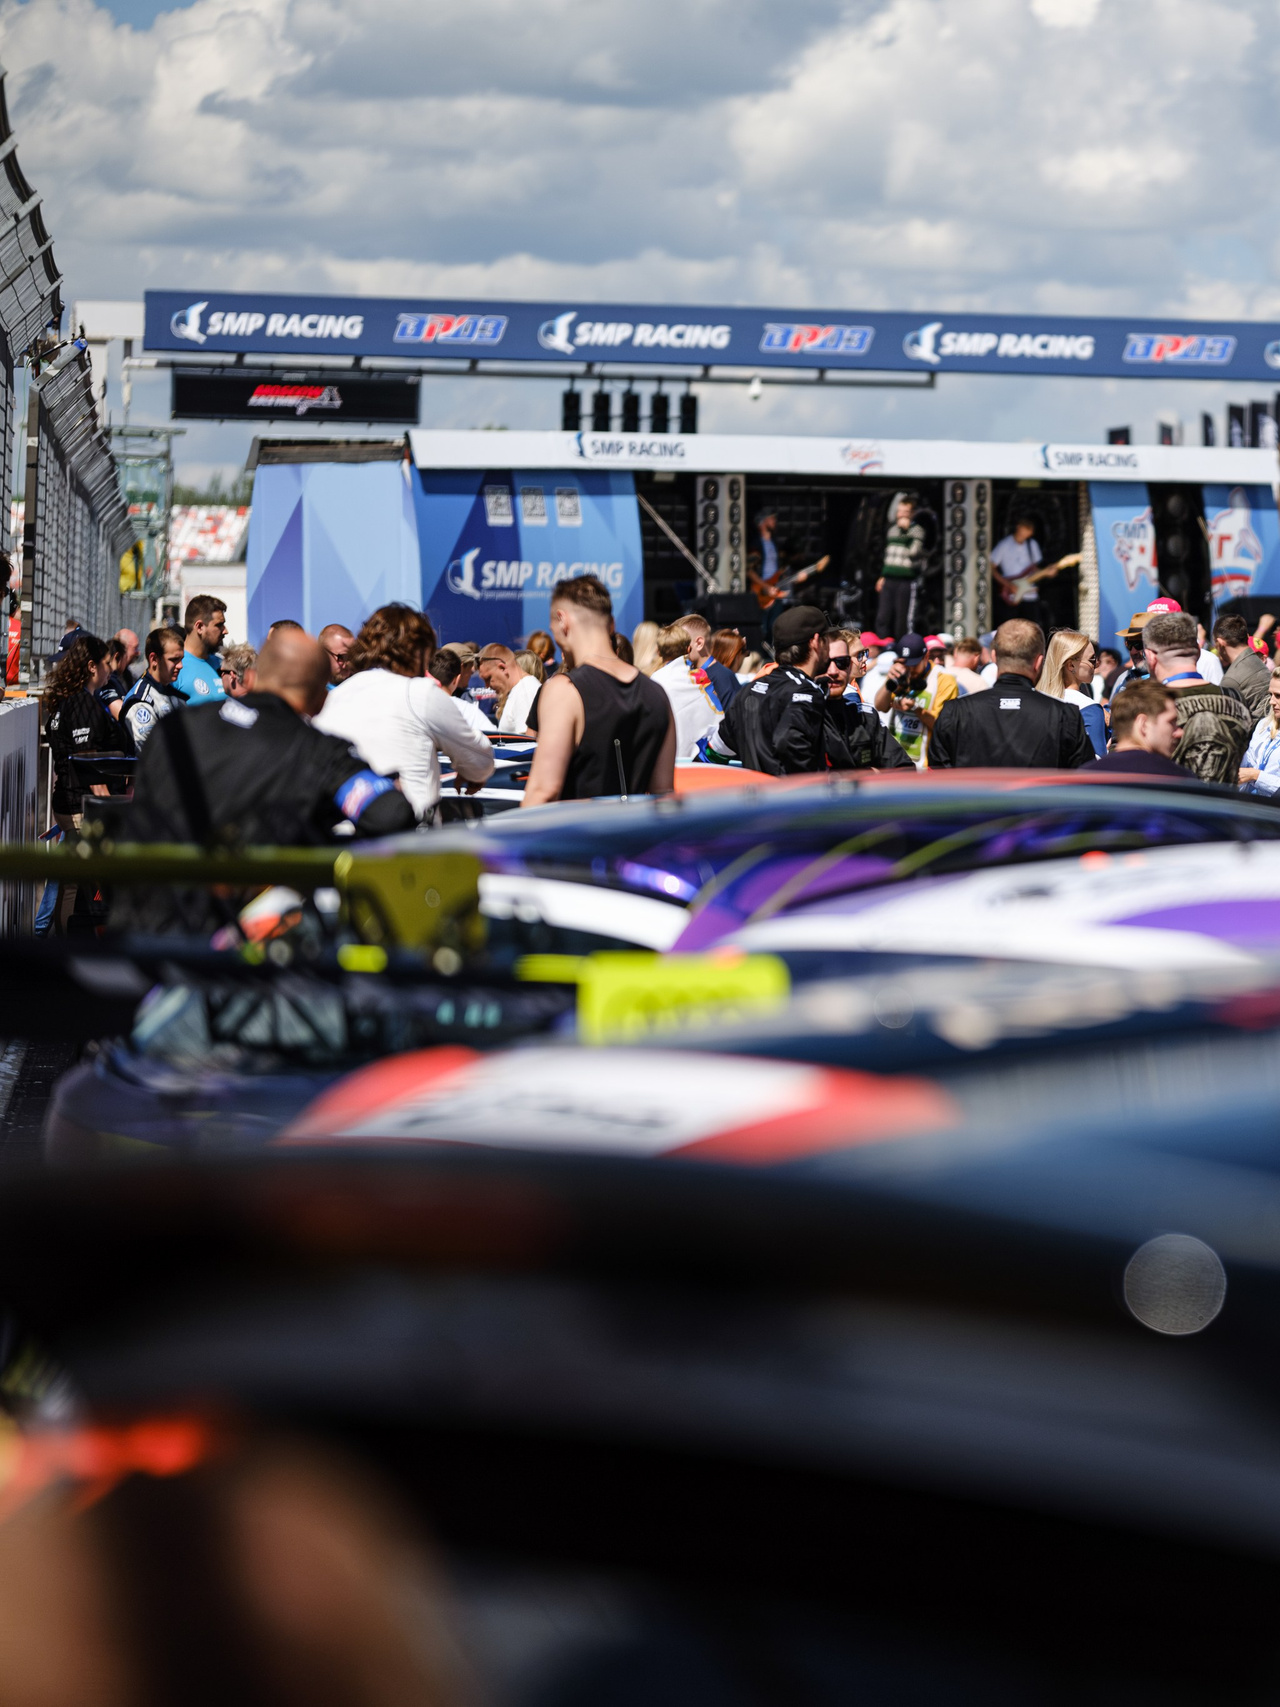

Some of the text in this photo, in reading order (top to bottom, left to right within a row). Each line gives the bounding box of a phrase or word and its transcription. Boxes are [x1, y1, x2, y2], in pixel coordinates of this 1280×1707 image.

[206, 311, 364, 339] SMP RACING
[573, 321, 731, 349] SMP RACING
[938, 332, 1095, 360] SMP RACING
[591, 440, 685, 457] SMP RACING
[1055, 452, 1137, 468] SMP RACING
[481, 560, 533, 589] SMP
